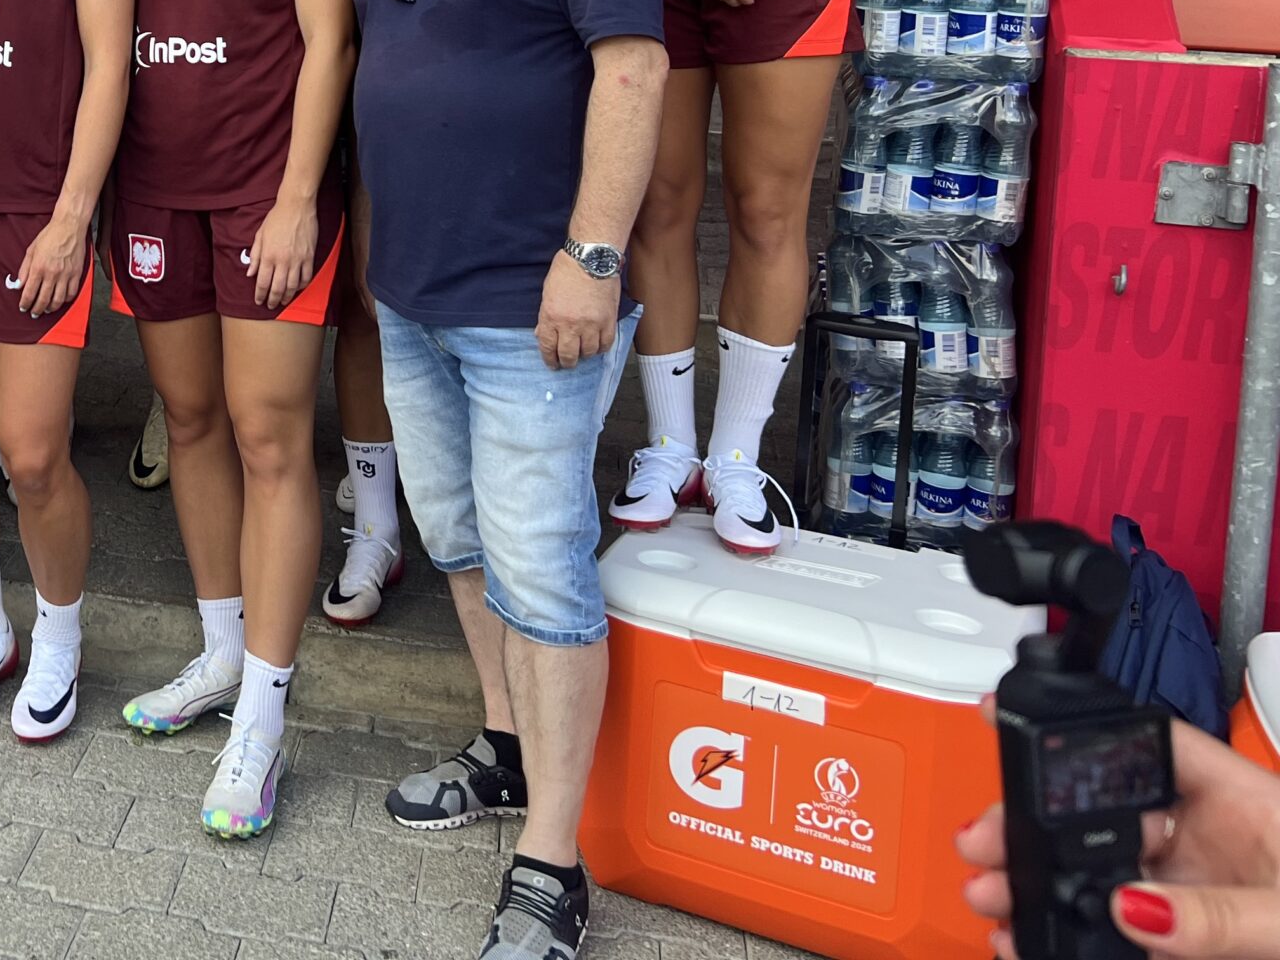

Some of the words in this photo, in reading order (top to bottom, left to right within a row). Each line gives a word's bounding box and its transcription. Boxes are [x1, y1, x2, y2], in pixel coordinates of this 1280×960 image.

[148, 36, 227, 65] InPost
[920, 490, 953, 505] ARKINA
[742, 685, 800, 713] 1-12
[669, 726, 744, 809] G
[669, 810, 745, 845] OFFICIAL
[750, 836, 814, 865] SPORTS
[820, 856, 876, 884] DRINK
[794, 824, 850, 847] SWITZERLAND
